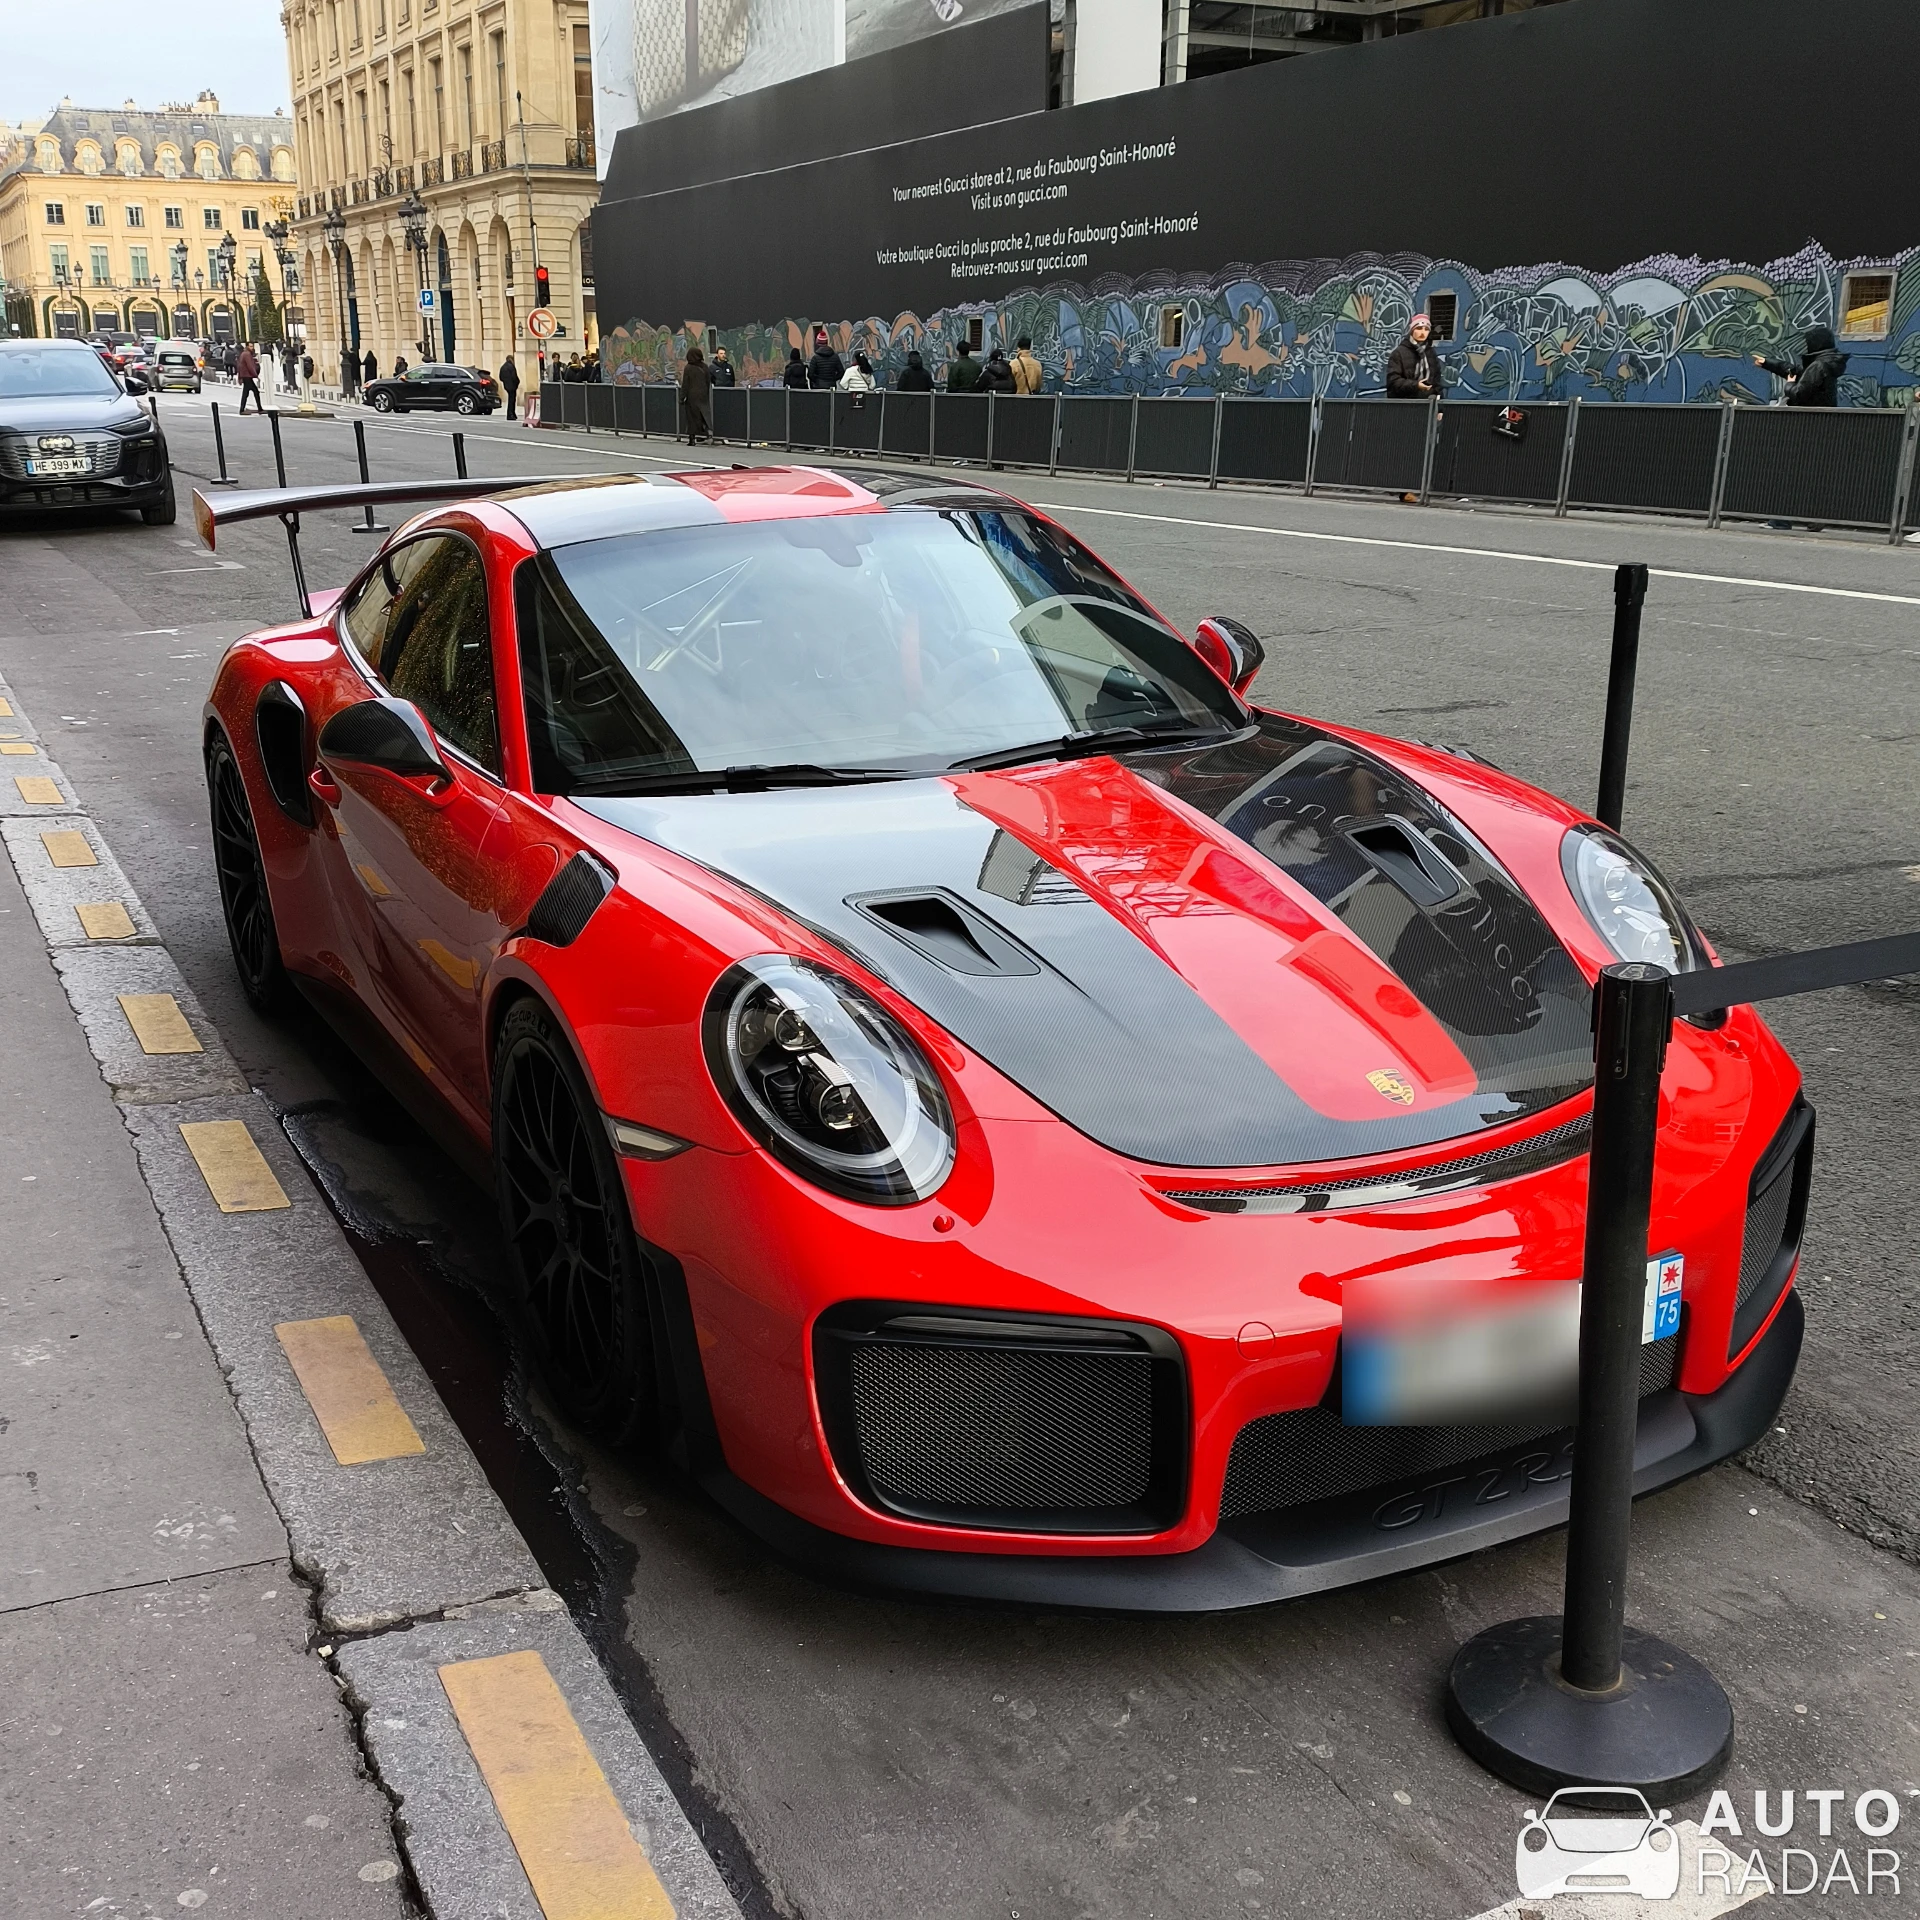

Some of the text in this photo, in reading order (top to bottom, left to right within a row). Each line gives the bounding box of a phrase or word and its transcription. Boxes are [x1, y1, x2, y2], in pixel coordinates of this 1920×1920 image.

[892, 135, 1176, 202] Your nearest Gucci store at 2, rue du Faubourg Saint-Honoré
[971, 183, 1068, 211] Visit us on gucci.com
[876, 210, 1199, 265] Votre boutique Gucci la plus proche 2, rue du Faubourg Saint-Honoré
[950, 251, 1088, 278] Retrouvez-nous sur gucci.com
[424, 292, 431, 304] P
[519, 1009, 532, 1023] CUP
[531, 1013, 537, 1026] 2
[1658, 1298, 1679, 1328] 75
